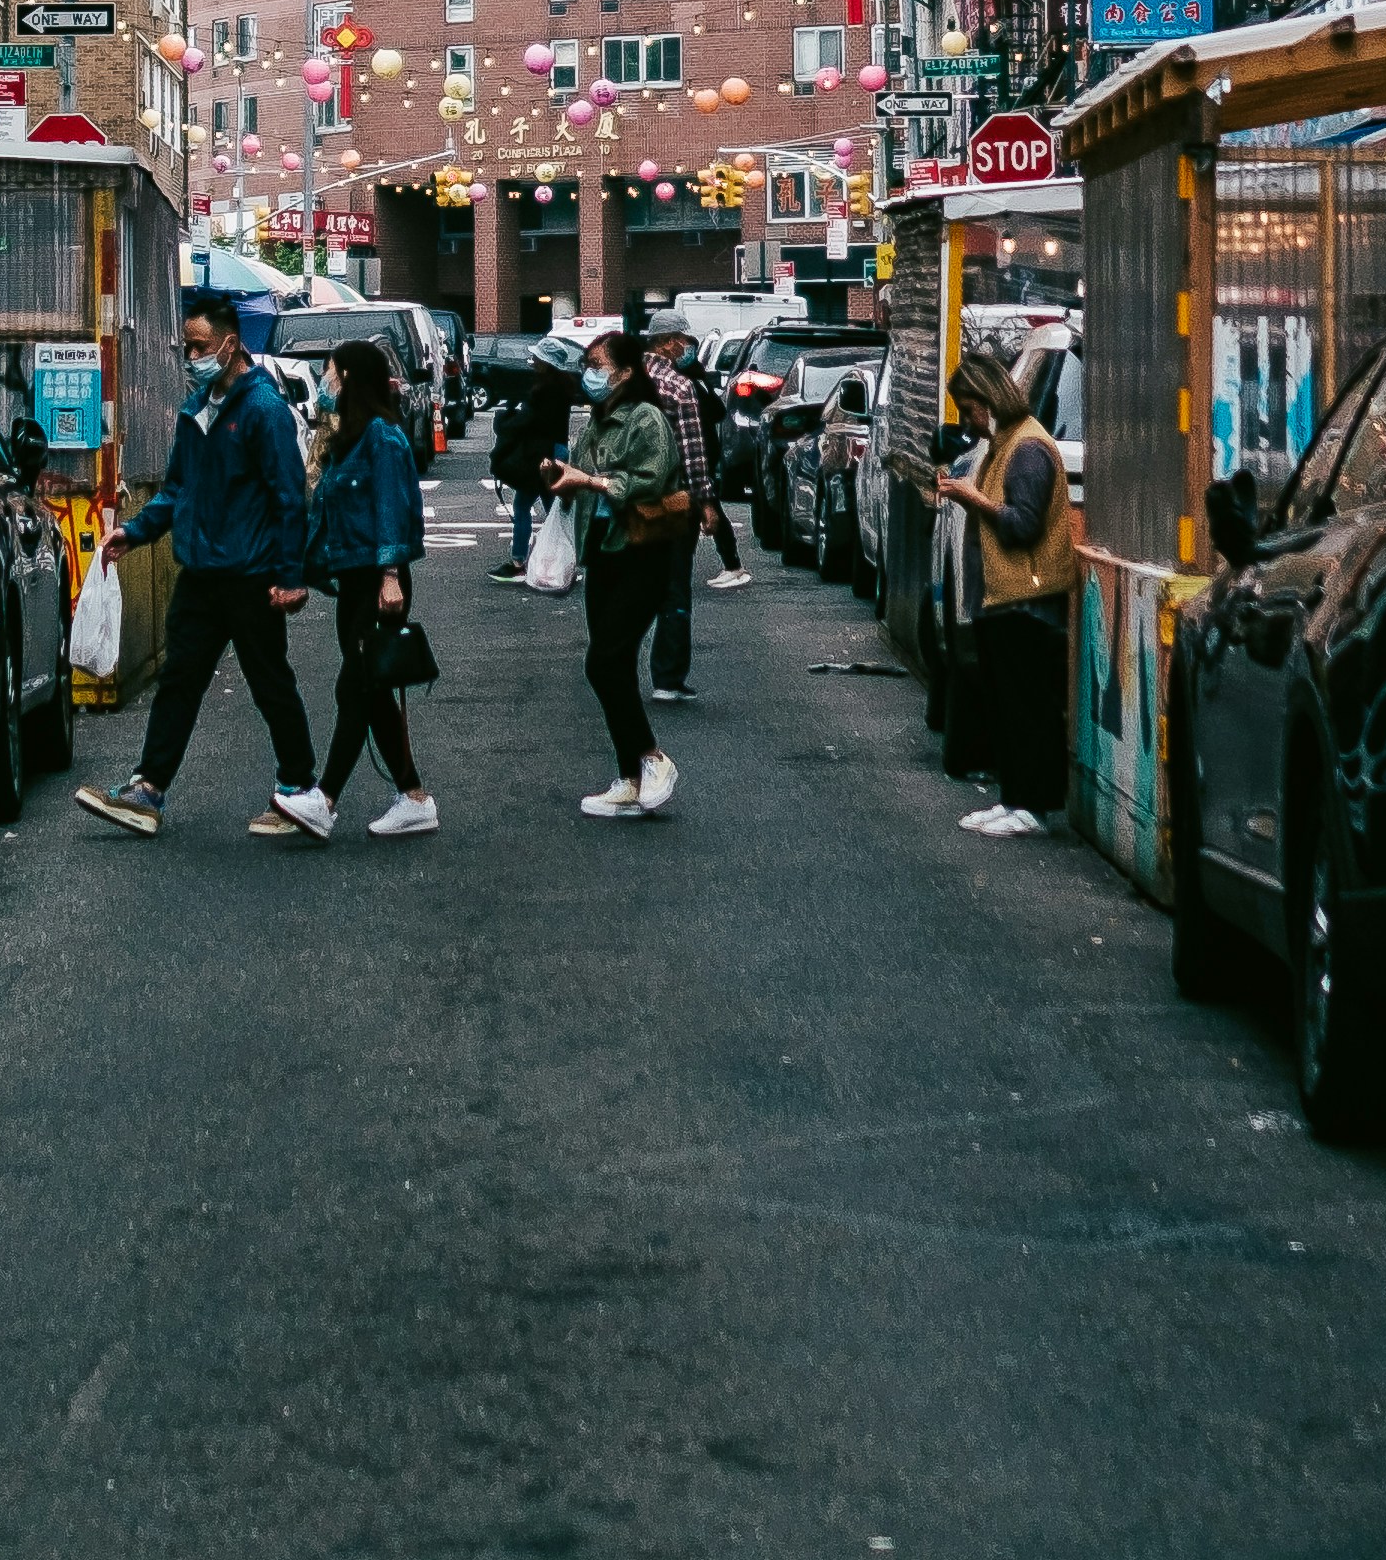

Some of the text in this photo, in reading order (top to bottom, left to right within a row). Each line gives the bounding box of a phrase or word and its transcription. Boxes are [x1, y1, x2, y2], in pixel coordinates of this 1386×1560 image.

[31, 12, 103, 26] ONE WAY
[924, 58, 989, 70] ELIZABETH
[884, 98, 947, 110] ONE WAY
[552, 144, 583, 158] PLAZA
[975, 140, 1048, 172] STOP
